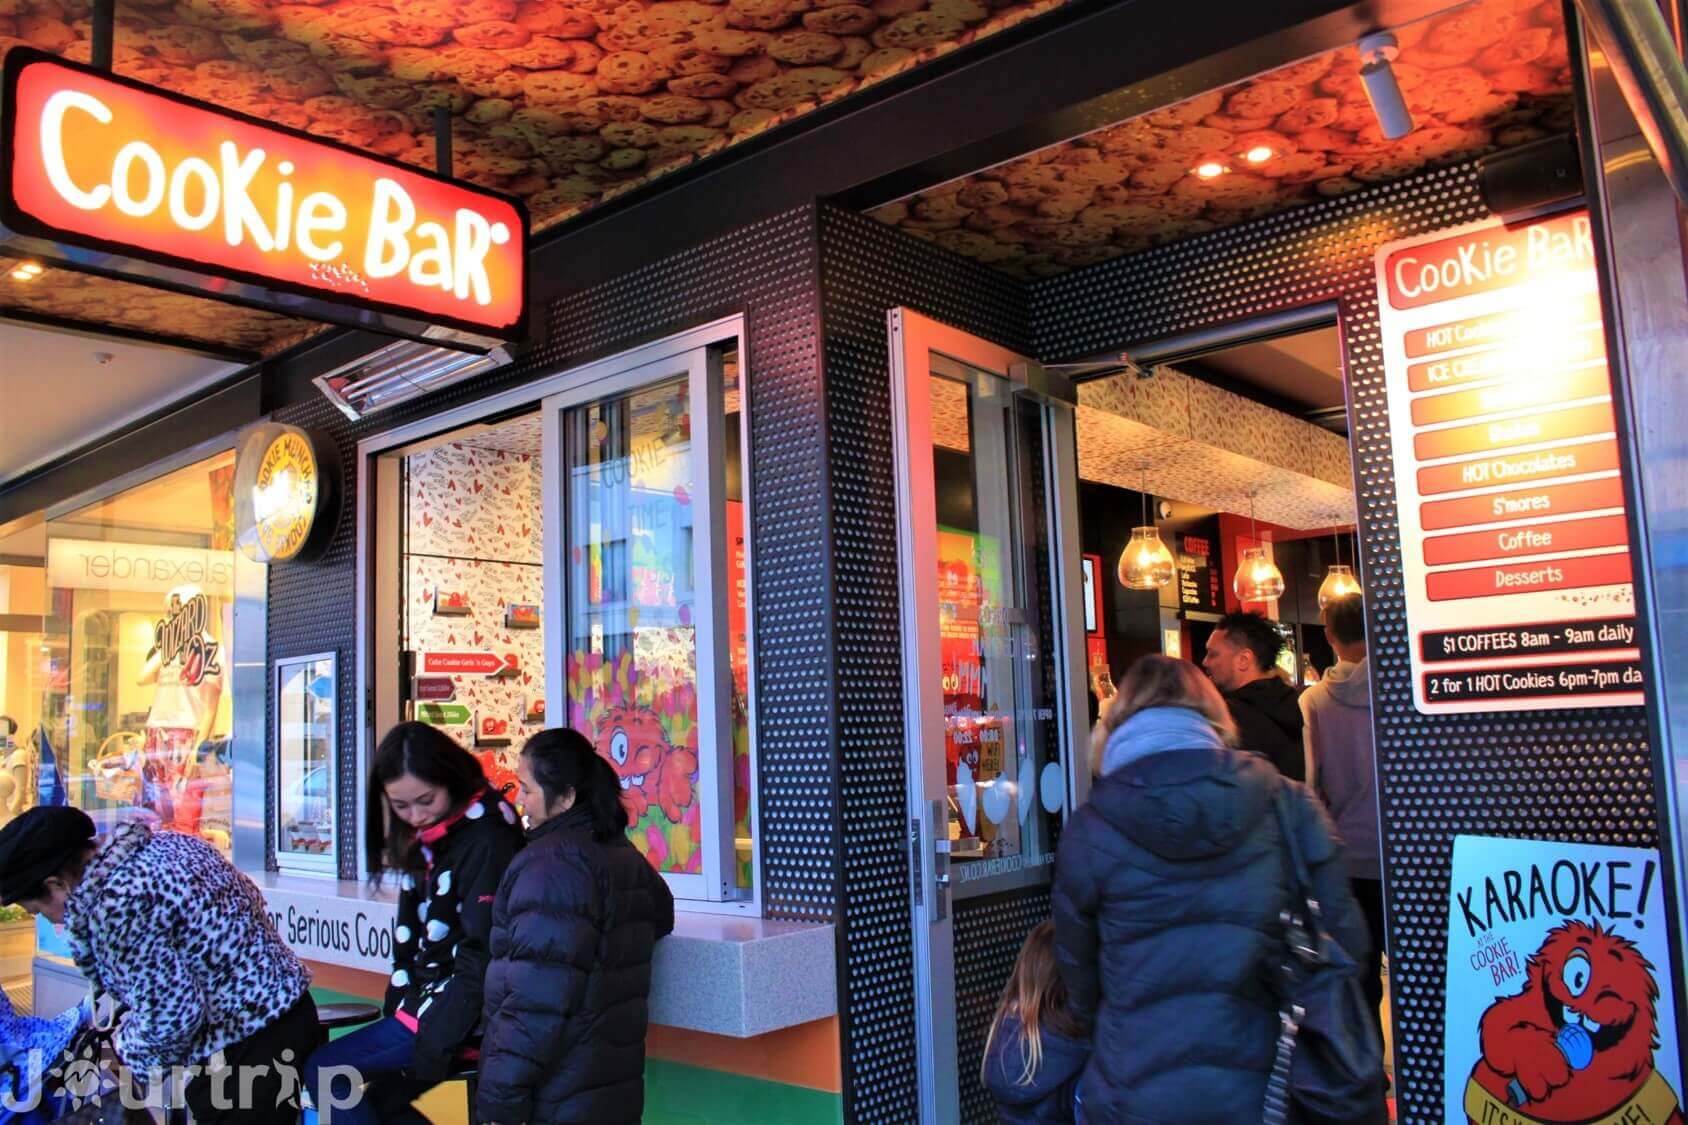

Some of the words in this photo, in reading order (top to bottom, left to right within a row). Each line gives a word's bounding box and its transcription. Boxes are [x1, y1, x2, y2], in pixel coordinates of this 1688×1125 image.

[1463, 463, 1490, 483] HOT
[1492, 453, 1576, 479] Chocolates
[1493, 495, 1551, 515] S'mores
[1498, 531, 1552, 551] Coffee
[1495, 566, 1563, 588] Desserts
[1443, 636, 1456, 654] $1
[1457, 633, 1517, 652] COFFEES
[1520, 631, 1550, 647] 8am
[1564, 627, 1595, 644] 9am
[1598, 623, 1634, 644] daily
[1430, 679, 1439, 694] 2
[1442, 677, 1462, 693] for
[1466, 677, 1473, 692] 1
[1475, 674, 1501, 692] HOT
[1502, 672, 1555, 690] Cookies
[1558, 668, 1620, 691] 6pm-7pm
[1457, 860, 1655, 938] KARAOKE!
[288, 905, 350, 952] Serious
[1470, 936, 1512, 971] COOKIE
[1490, 951, 1522, 986] BAR!
